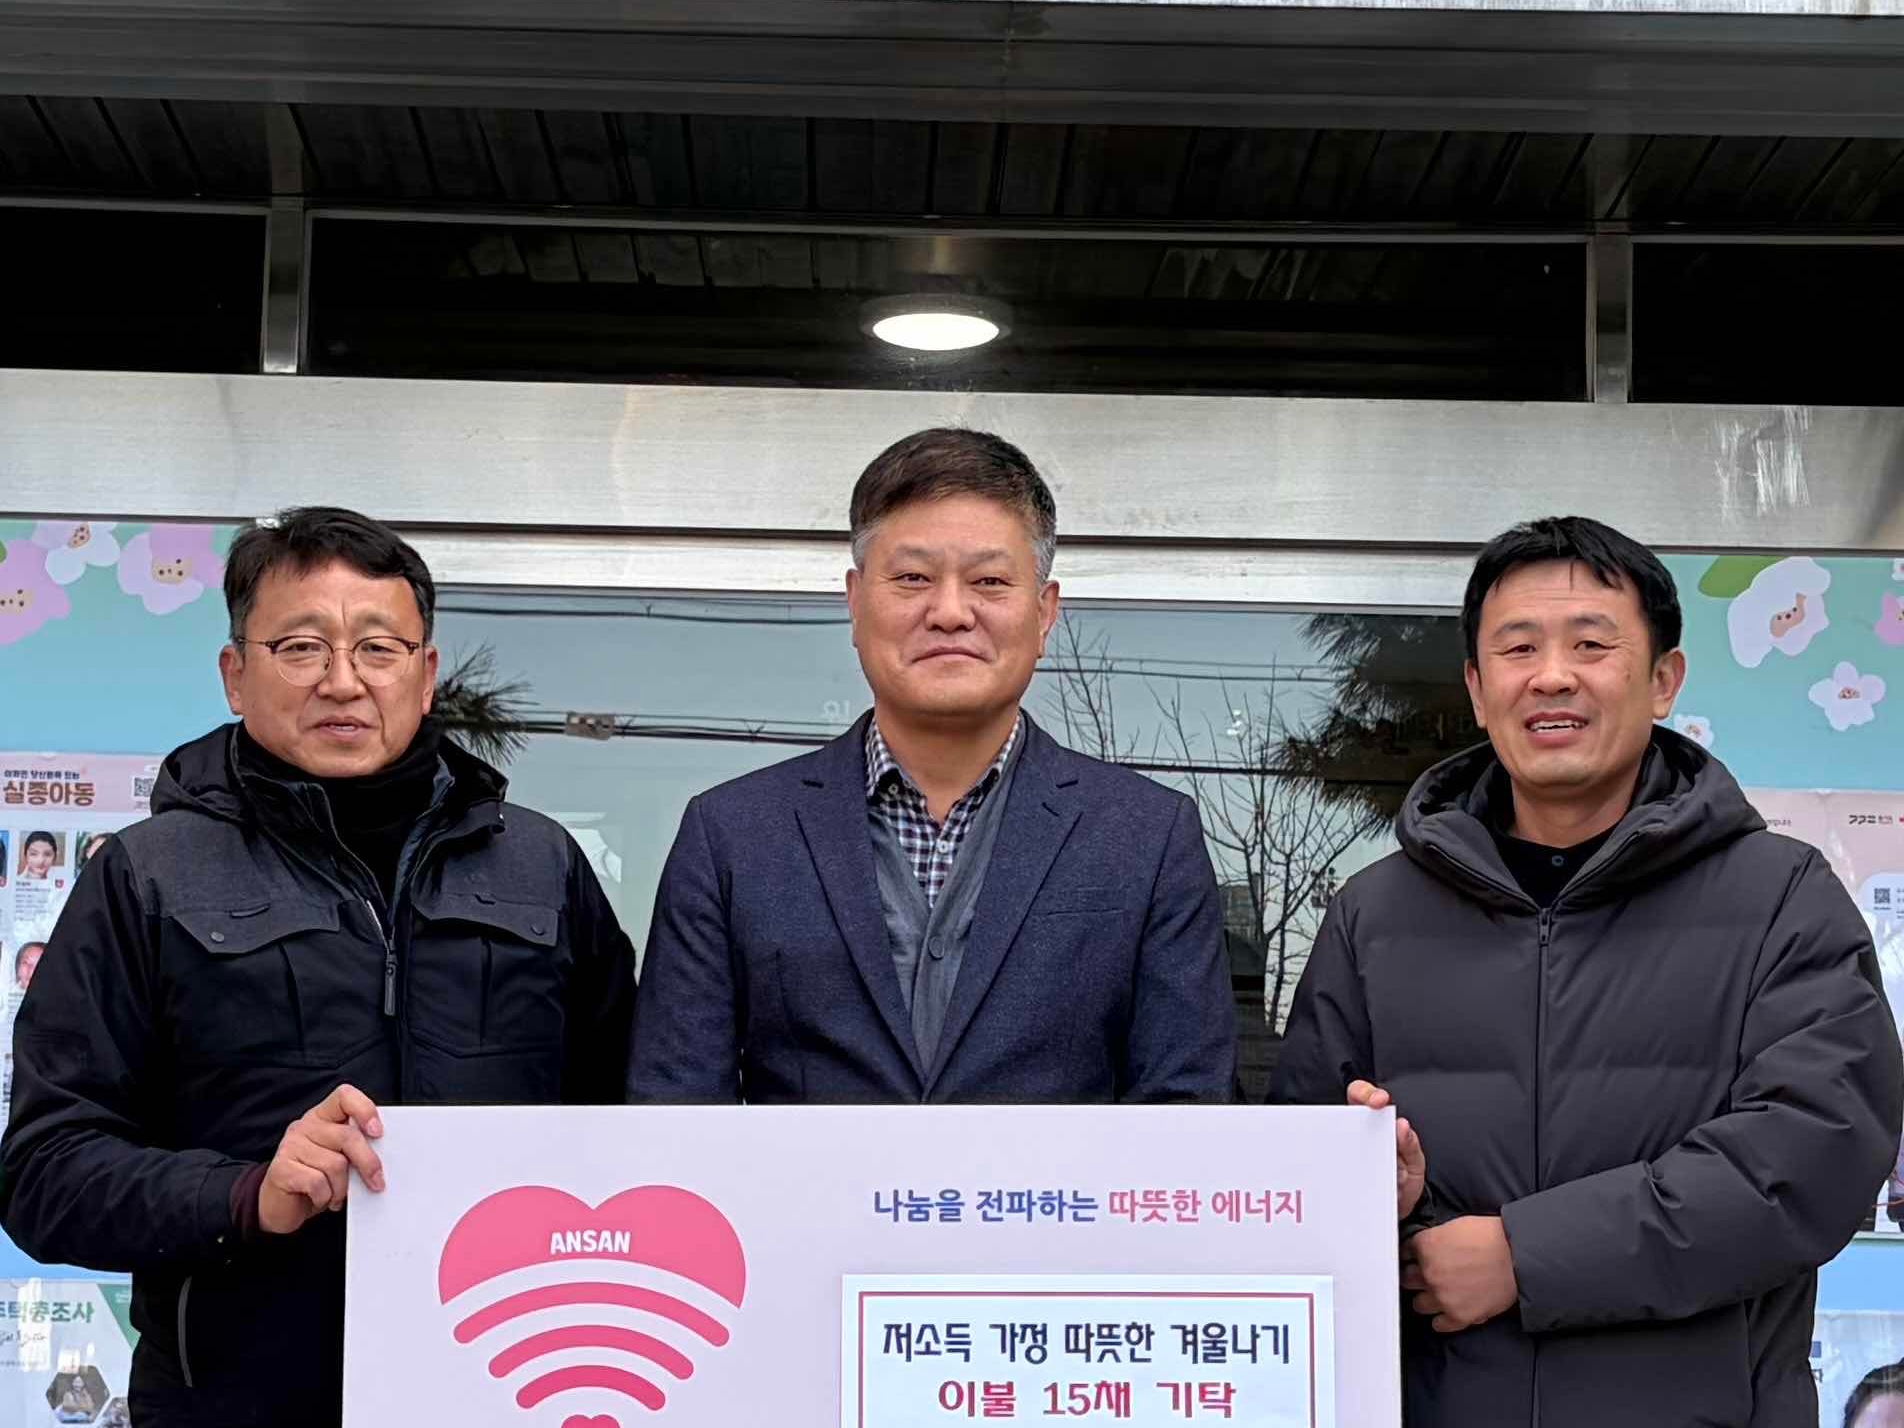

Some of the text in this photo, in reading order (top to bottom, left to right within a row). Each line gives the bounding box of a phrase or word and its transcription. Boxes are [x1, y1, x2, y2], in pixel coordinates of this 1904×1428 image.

[3, 781, 96, 807] 실종아동
[873, 1188, 1304, 1224] 나눔을 전파하는 따뜻한 에너지
[549, 1230, 632, 1255] ANSAN
[882, 1321, 1290, 1365] 저소득 가정 따뜻한 겨울나기
[937, 1379, 1237, 1419] 이불 15채 기탁
